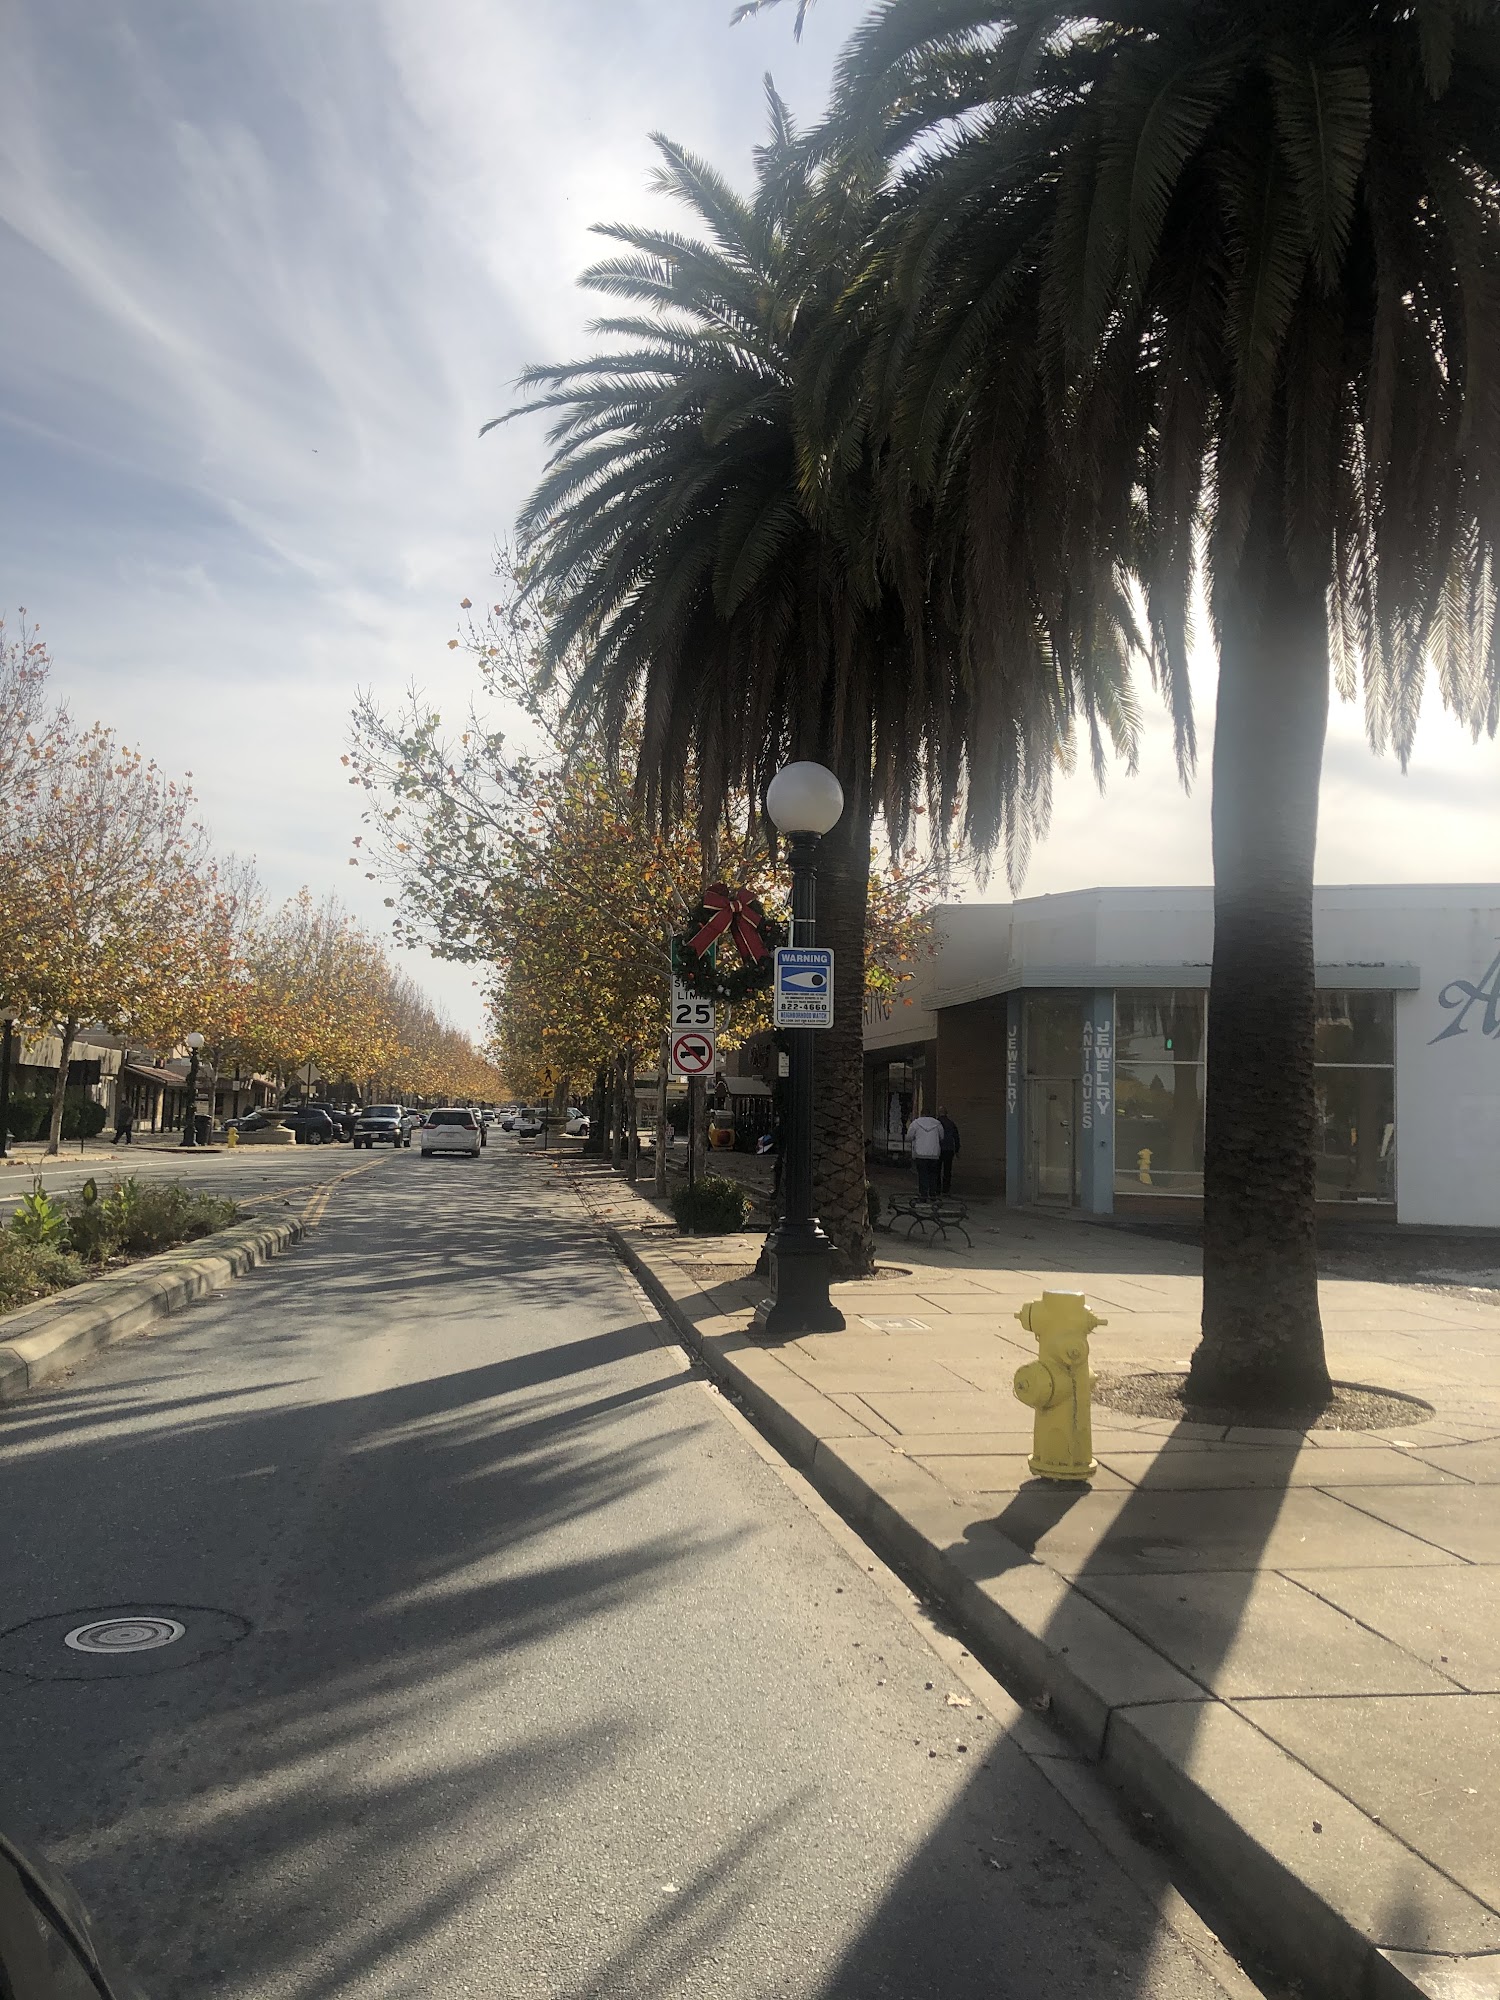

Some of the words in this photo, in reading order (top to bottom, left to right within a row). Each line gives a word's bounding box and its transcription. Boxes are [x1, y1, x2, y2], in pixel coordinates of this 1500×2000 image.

[781, 953, 828, 963] WARNING
[677, 992, 708, 1000] LIM
[676, 1004, 710, 1024] 25
[781, 1003, 827, 1011] 822-4660
[1007, 1026, 1018, 1114] JEWELRY
[1082, 1021, 1093, 1129] ANTIQUES
[1094, 1021, 1112, 1115] JEWELRY
